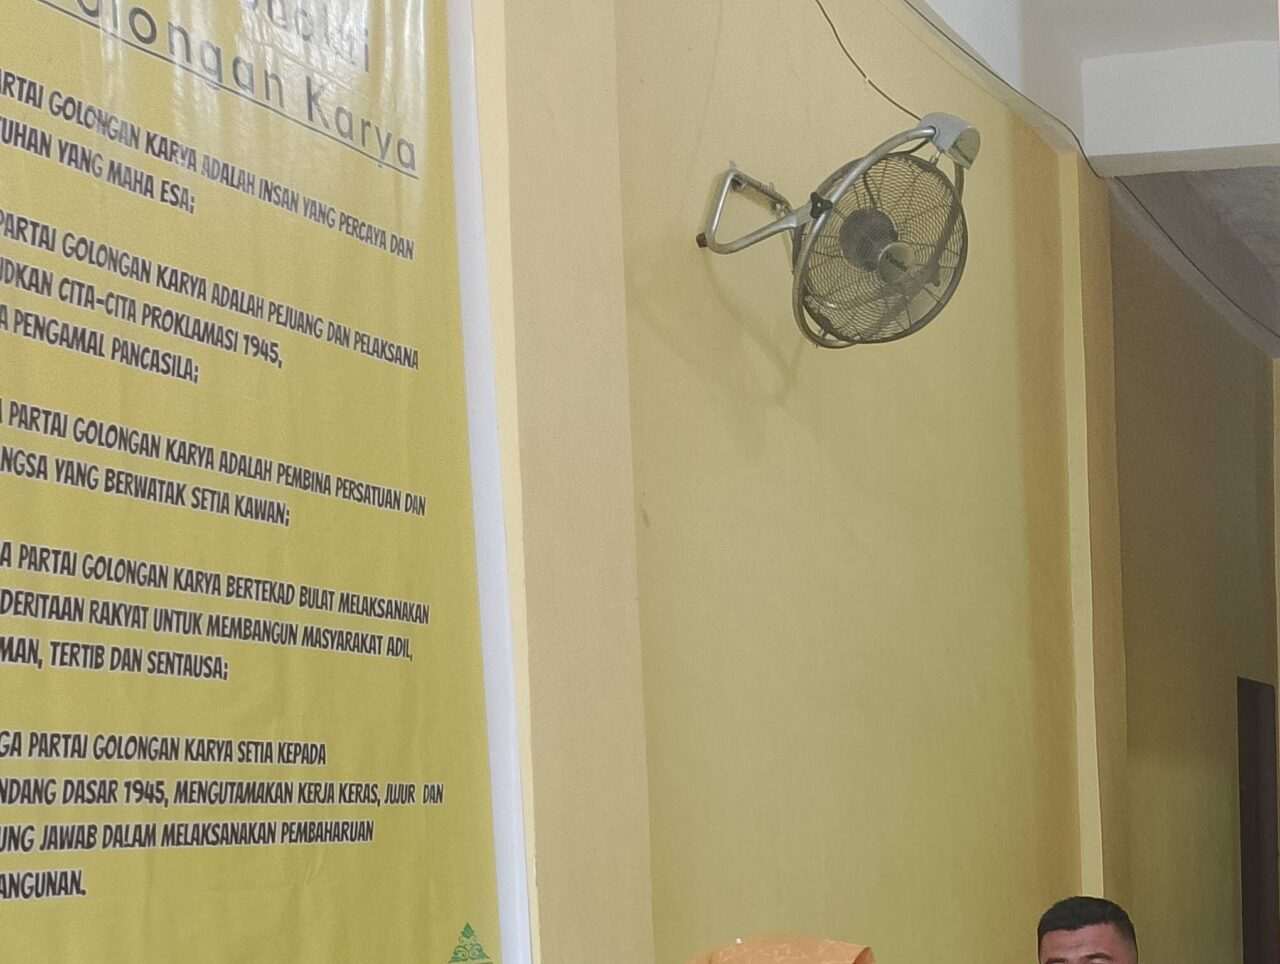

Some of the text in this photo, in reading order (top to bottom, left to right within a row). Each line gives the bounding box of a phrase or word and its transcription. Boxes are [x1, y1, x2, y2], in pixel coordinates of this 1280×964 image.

[307, 76, 416, 171] Karya
[0, 69, 415, 260] RTAI GOLONGAN KARYA ADALAH INSAN YANG PERCAYA DAN
[58, 139, 103, 178] YANG
[107, 160, 155, 199] MAHA
[160, 180, 195, 214] ESA;
[58, 277, 137, 323] CITA-CITA
[141, 302, 239, 353] PROKLAMASI
[243, 334, 283, 369] 1945,
[62, 232, 152, 284] GOLONGAN
[156, 263, 207, 302] KARYA
[211, 282, 264, 319] ADALAH
[268, 303, 323, 340] PEJUANG
[327, 323, 350, 349] DAN
[353, 333, 420, 370] PELAKSANA
[14, 308, 104, 358] PENGAMAL
[112, 337, 199, 384] PANCASILA;
[8, 400, 427, 517] PARTAI GOLONGAN KARYA ADALAH PEMBINA PERSATUAN DAN
[55, 457, 99, 491] YANG
[104, 468, 186, 507] BERWATAK
[191, 487, 230, 516] SETIA
[234, 494, 290, 527] KAWAN;
[18, 543, 77, 576] PARTAI
[82, 553, 168, 589] GOLONGAN
[173, 567, 221, 597] KARYA
[226, 574, 295, 606] BERTEKAD
[299, 587, 335, 612] BULAT
[338, 591, 430, 625] MELAKSANAKAN
[50, 641, 105, 670] TERTIB
[110, 650, 142, 673] DAN
[147, 651, 228, 681] SENTAUSA;
[89, 599, 149, 630] RAKYAT
[153, 607, 202, 636] UNTUK
[206, 612, 298, 646] MEMBANGUN
[302, 624, 384, 657] MASYARAKAT
[386, 634, 414, 662] ADIL,
[28, 732, 88, 758] PARTAI
[93, 734, 179, 761] GOLONGAN
[185, 738, 233, 763] KARYA
[237, 740, 273, 764] SETIA
[277, 741, 326, 765] KEPADA
[62, 779, 118, 805] DASAR
[124, 779, 169, 808] 1945,
[173, 781, 293, 805] MENGUTAMAKAN
[298, 781, 335, 804] KERJA
[339, 781, 381, 807] KERAS,
[384, 783, 416, 804] JUJUR
[422, 784, 444, 804] DAN
[39, 824, 98, 851] JAWAB
[101, 823, 157, 849] DALAM
[161, 821, 276, 847] MELAKSANAKAN
[281, 820, 374, 843] PEMBAHARUAN
